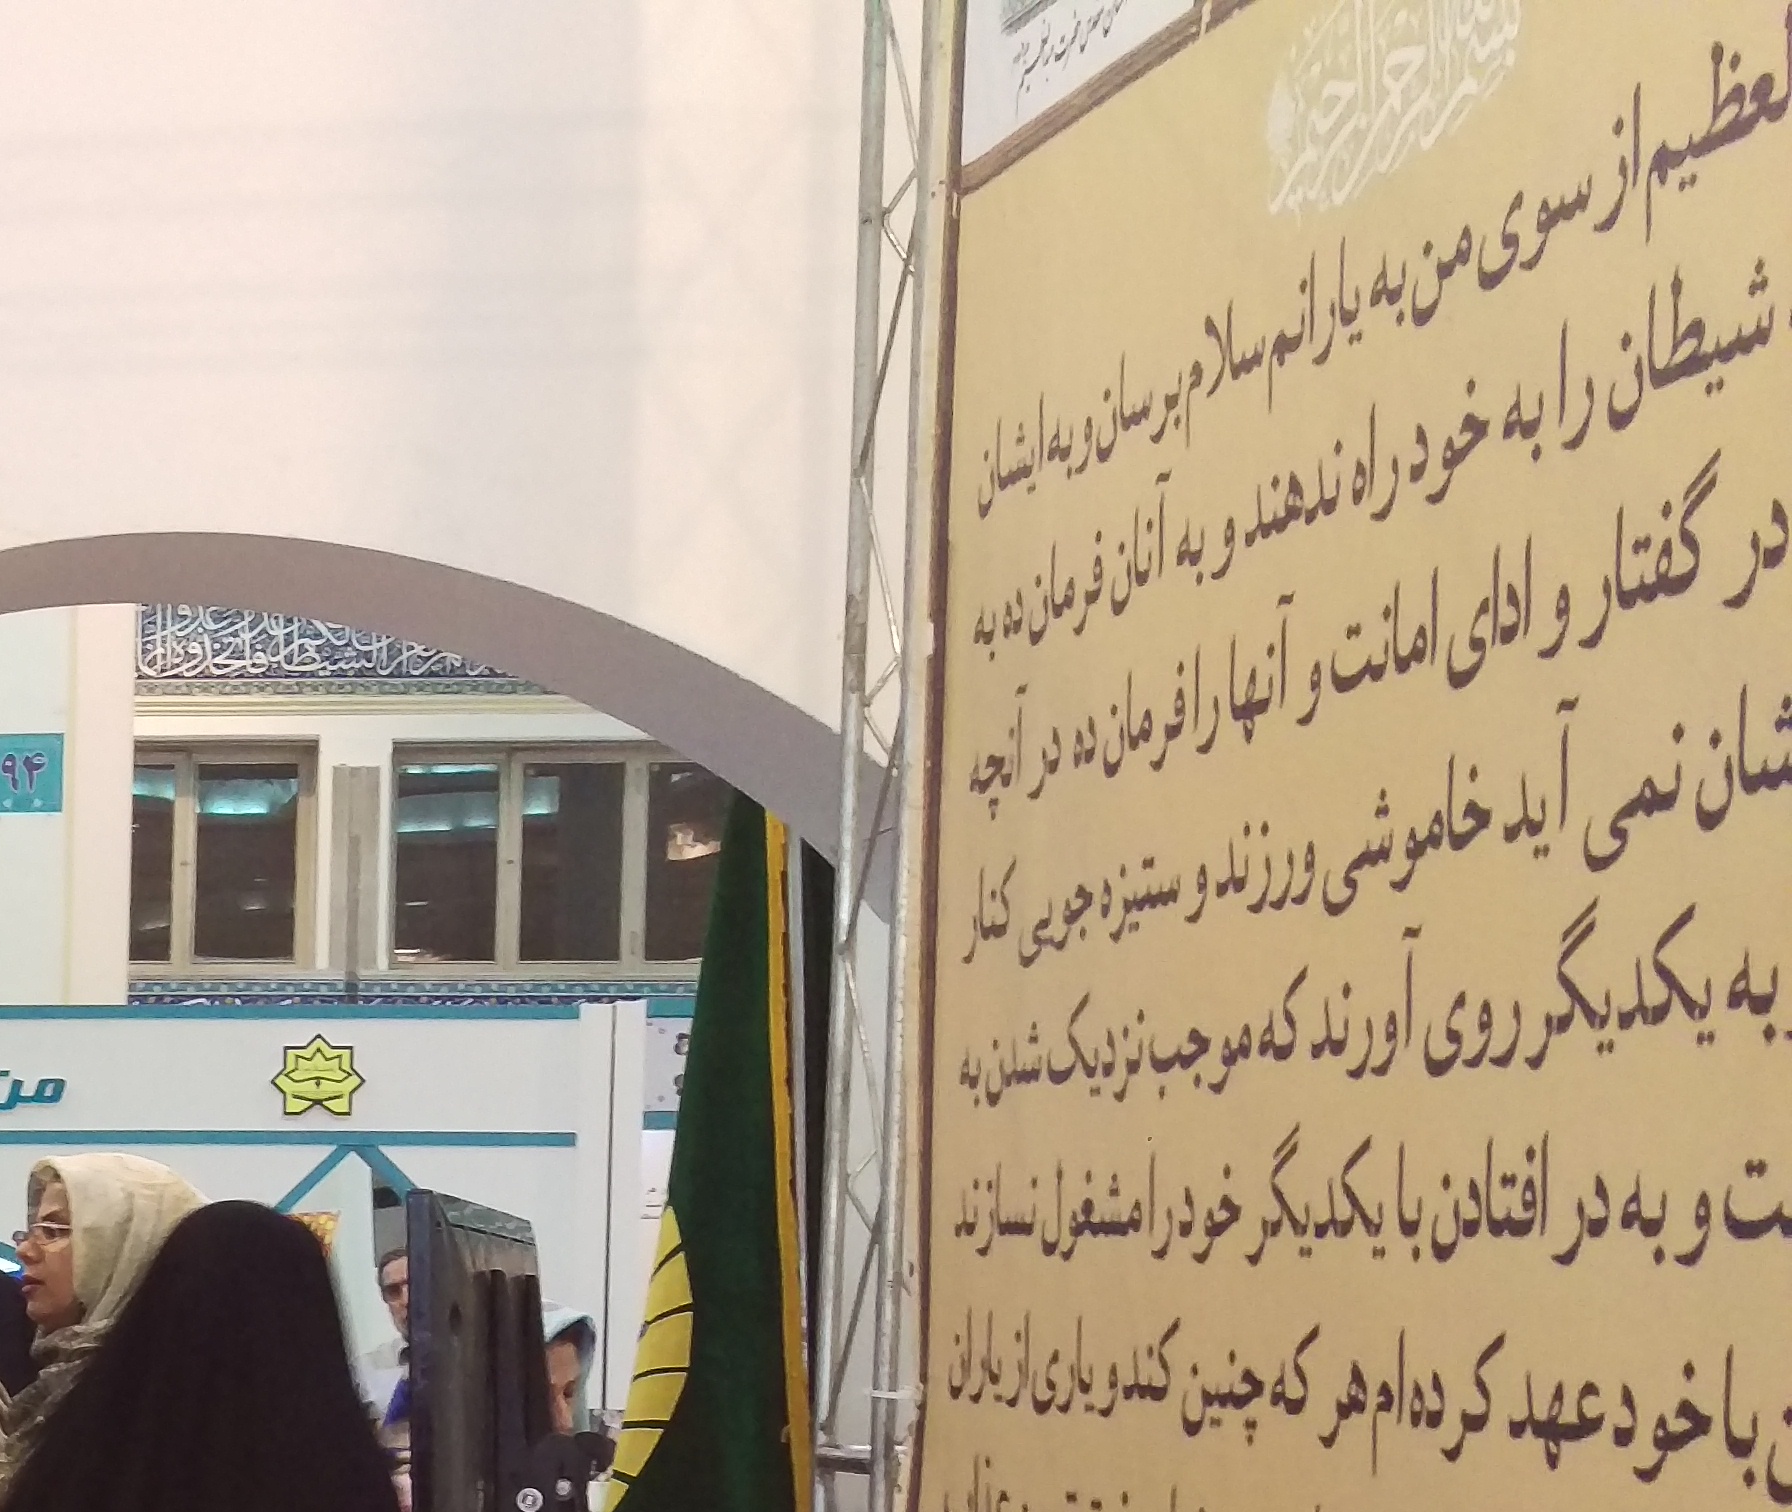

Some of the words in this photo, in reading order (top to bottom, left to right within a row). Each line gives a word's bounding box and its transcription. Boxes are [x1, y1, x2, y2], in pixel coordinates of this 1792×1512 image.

[1592, 82, 1641, 233] از
[1411, 224, 1473, 328] من
[1477, 173, 1592, 292] سوی
[1268, 236, 1363, 413] یارانم
[1369, 253, 1406, 327] به
[1185, 299, 1266, 448] سلام
[1558, 318, 1594, 452] را
[1607, 256, 1775, 433] شیطان
[978, 392, 1044, 520] ایشان
[1047, 418, 1073, 480] به
[1073, 416, 1093, 475] و
[1096, 352, 1182, 464] برسان
[1409, 378, 1490, 506] خود
[1502, 383, 1544, 463] به
[1244, 439, 1343, 548] ندهند
[1352, 402, 1399, 522] راه
[1028, 530, 1104, 647] فرمان
[1110, 468, 1172, 617] آنان
[1176, 518, 1205, 586] به
[1210, 516, 1236, 580] و
[1577, 448, 1721, 650] گفتار
[1721, 498, 1789, 609] در
[973, 606, 997, 662] به
[1003, 588, 1023, 639] ده
[1330, 566, 1438, 694] امانت
[1446, 534, 1532, 690] ادای
[1537, 583, 1570, 660] و
[1193, 644, 1220, 755] را
[1229, 591, 1296, 745] آنها
[1295, 659, 1321, 727] و
[969, 683, 1028, 821] آنچه
[1027, 726, 1061, 801] در
[1073, 716, 1097, 769] ده
[1103, 661, 1186, 778] فرمان
[1, 752, 48, 793] ۹۴
[1503, 695, 1580, 860] آید
[1583, 721, 1685, 873] نمی
[1215, 821, 1316, 915] ورزند
[1321, 753, 1493, 917] خاموشی
[961, 856, 1016, 964] کنار
[1100, 856, 1181, 944] ستیزه
[1184, 863, 1208, 924] و
[1257, 964, 1309, 1062] که
[1310, 924, 1423, 1080] آورند
[1523, 895, 1716, 1070] یکدیگر
[1726, 948, 1778, 1046] به
[959, 1048, 981, 1108] به
[985, 1021, 1042, 1108] شدن
[1046, 992, 1145, 1103] نزدیک
[1148, 1023, 1252, 1100] موجب
[1423, 990, 1522, 1078] روی
[954, 1162, 1038, 1258] نسازند
[1041, 1160, 1143, 1262] مشغول
[1148, 1152, 1173, 1261] را
[1178, 1163, 1242, 1265] خود
[1244, 1122, 1386, 1267] یکدیگر
[1397, 1141, 1423, 1263] با
[1619, 1173, 1667, 1266] به
[1673, 1189, 1712, 1269] و
[948, 1307, 1005, 1404] یاران
[1004, 1312, 1030, 1408] از
[1031, 1316, 1097, 1416] یاری
[1096, 1362, 1119, 1418] و
[1122, 1317, 1182, 1402] کند
[1181, 1349, 1266, 1447] چنین
[1269, 1322, 1320, 1415] که
[1317, 1360, 1369, 1449] هر
[1507, 1370, 1605, 1472] عهد
[1611, 1359, 1714, 1485] خود
[1722, 1344, 1759, 1489] با
